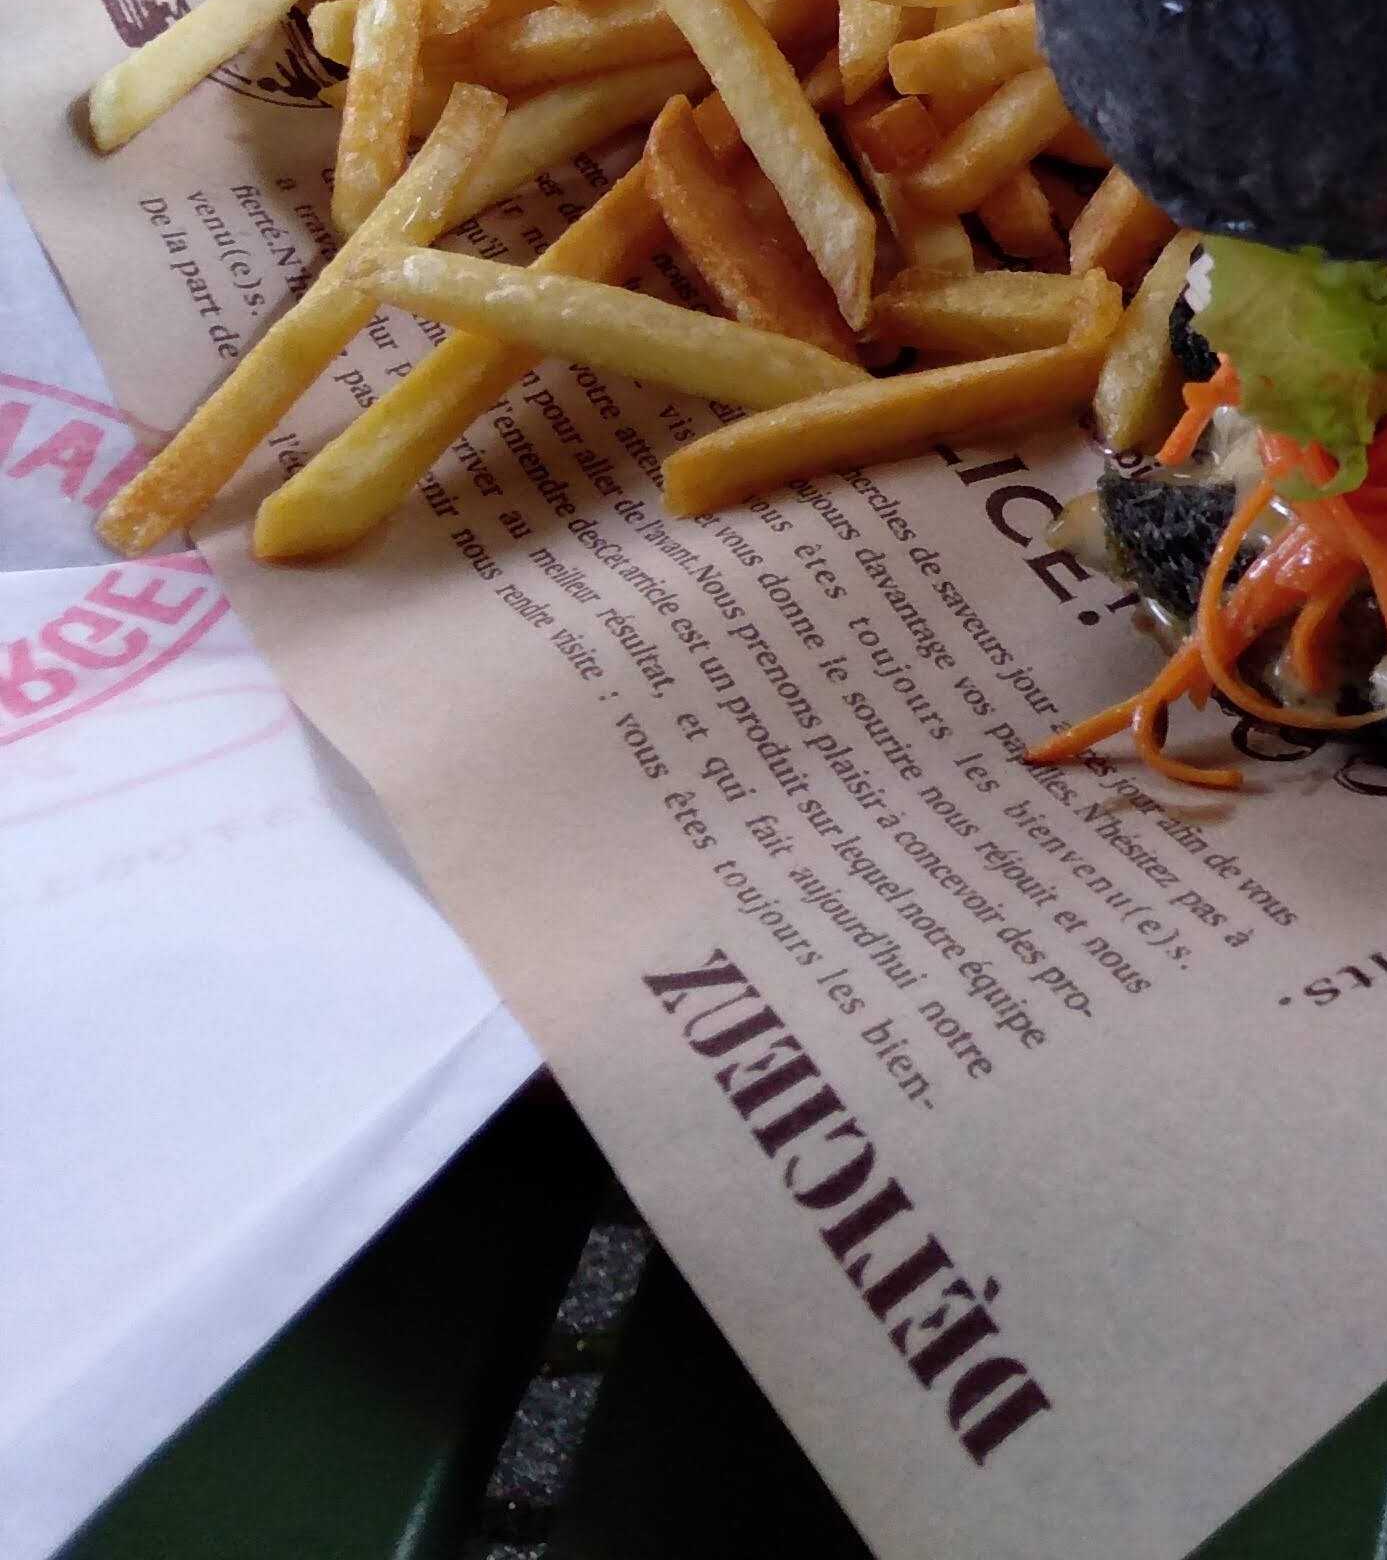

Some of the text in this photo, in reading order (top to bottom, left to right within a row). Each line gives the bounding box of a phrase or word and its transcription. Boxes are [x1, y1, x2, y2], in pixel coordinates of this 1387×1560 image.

[170, 260, 221, 316] part
[208, 325, 251, 358] de
[618, 566, 679, 615] article
[671, 618, 710, 653] est
[522, 389, 582, 442] pour
[614, 500, 644, 523] de
[727, 623, 821, 728] prenons
[802, 734, 886, 809] plaisir
[894, 831, 1004, 922] concevoir
[996, 927, 1045, 964] des
[1028, 966, 1091, 1017] pro-
[699, 656, 734, 691] un
[794, 544, 846, 598] êtes
[848, 617, 951, 739] toujours
[953, 753, 999, 791] les
[715, 526, 763, 566] vous
[757, 573, 823, 648] donne
[819, 656, 847, 680] le
[842, 692, 922, 780] sourire
[917, 786, 979, 836] nous
[974, 841, 1057, 907] réjouit
[1052, 911, 1087, 932] et
[1081, 937, 1151, 993] nous
[716, 696, 808, 796] produit
[855, 548, 955, 669] davantage
[954, 676, 994, 715] vos
[1168, 890, 1227, 926] pas
[1224, 929, 1253, 946] à
[909, 547, 940, 575] de
[931, 581, 1013, 664] saveurs
[995, 667, 1058, 714] jour
[1203, 854, 1241, 878] de
[1237, 878, 1297, 925] vous
[451, 528, 502, 580] nous
[495, 584, 554, 627] rendre
[550, 628, 602, 679] visite
[616, 713, 668, 778] vous
[664, 792, 716, 849] êtes
[713, 860, 822, 965] toujours
[816, 968, 864, 1014] les
[861, 1018, 933, 1109] bien-
[499, 511, 531, 539] au
[529, 548, 600, 603] meilleur
[596, 608, 674, 697] résultat,
[677, 713, 708, 741] et
[701, 757, 756, 801] qui
[745, 815, 792, 857] fait
[788, 867, 926, 988] aujourd'hui
[918, 1001, 991, 1078] notre
[797, 799, 842, 836] sur
[831, 835, 913, 902] lequel
[896, 902, 965, 959] notre
[958, 961, 1044, 1048] équipe
